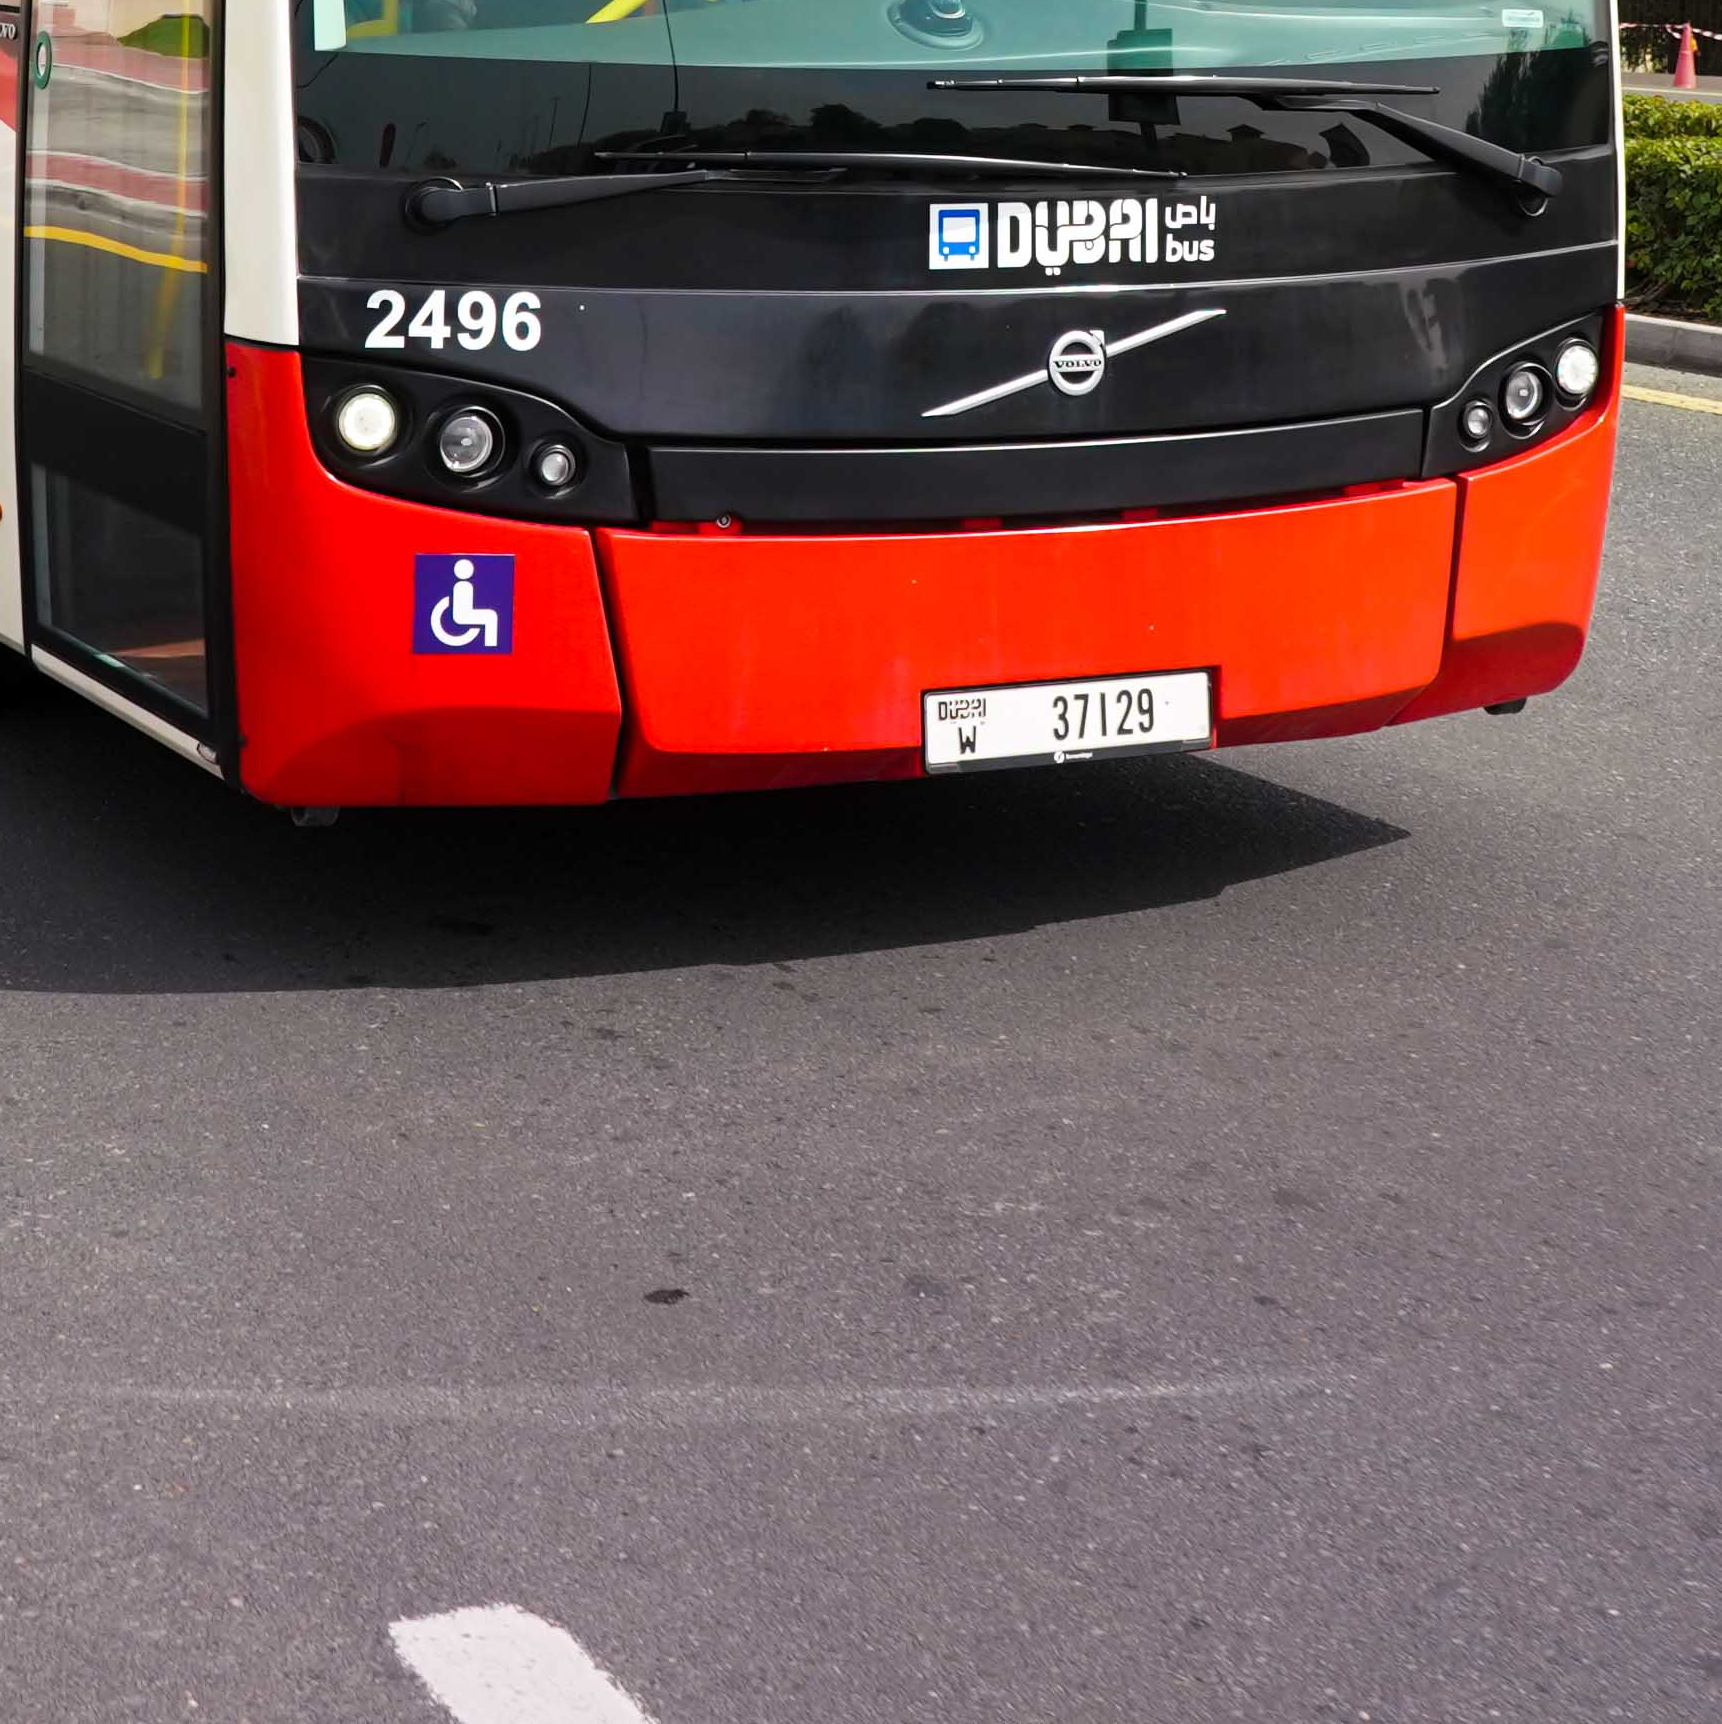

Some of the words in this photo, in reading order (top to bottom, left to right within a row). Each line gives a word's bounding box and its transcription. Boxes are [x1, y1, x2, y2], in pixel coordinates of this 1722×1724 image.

[1164, 195, 1217, 231] باص
[997, 197, 1159, 276] DUBAI
[1165, 233, 1216, 263] bus
[364, 289, 542, 352] 2496
[1053, 359, 1102, 369] VOLVO
[1052, 687, 1155, 741] 37129
[958, 725, 977, 755] W
